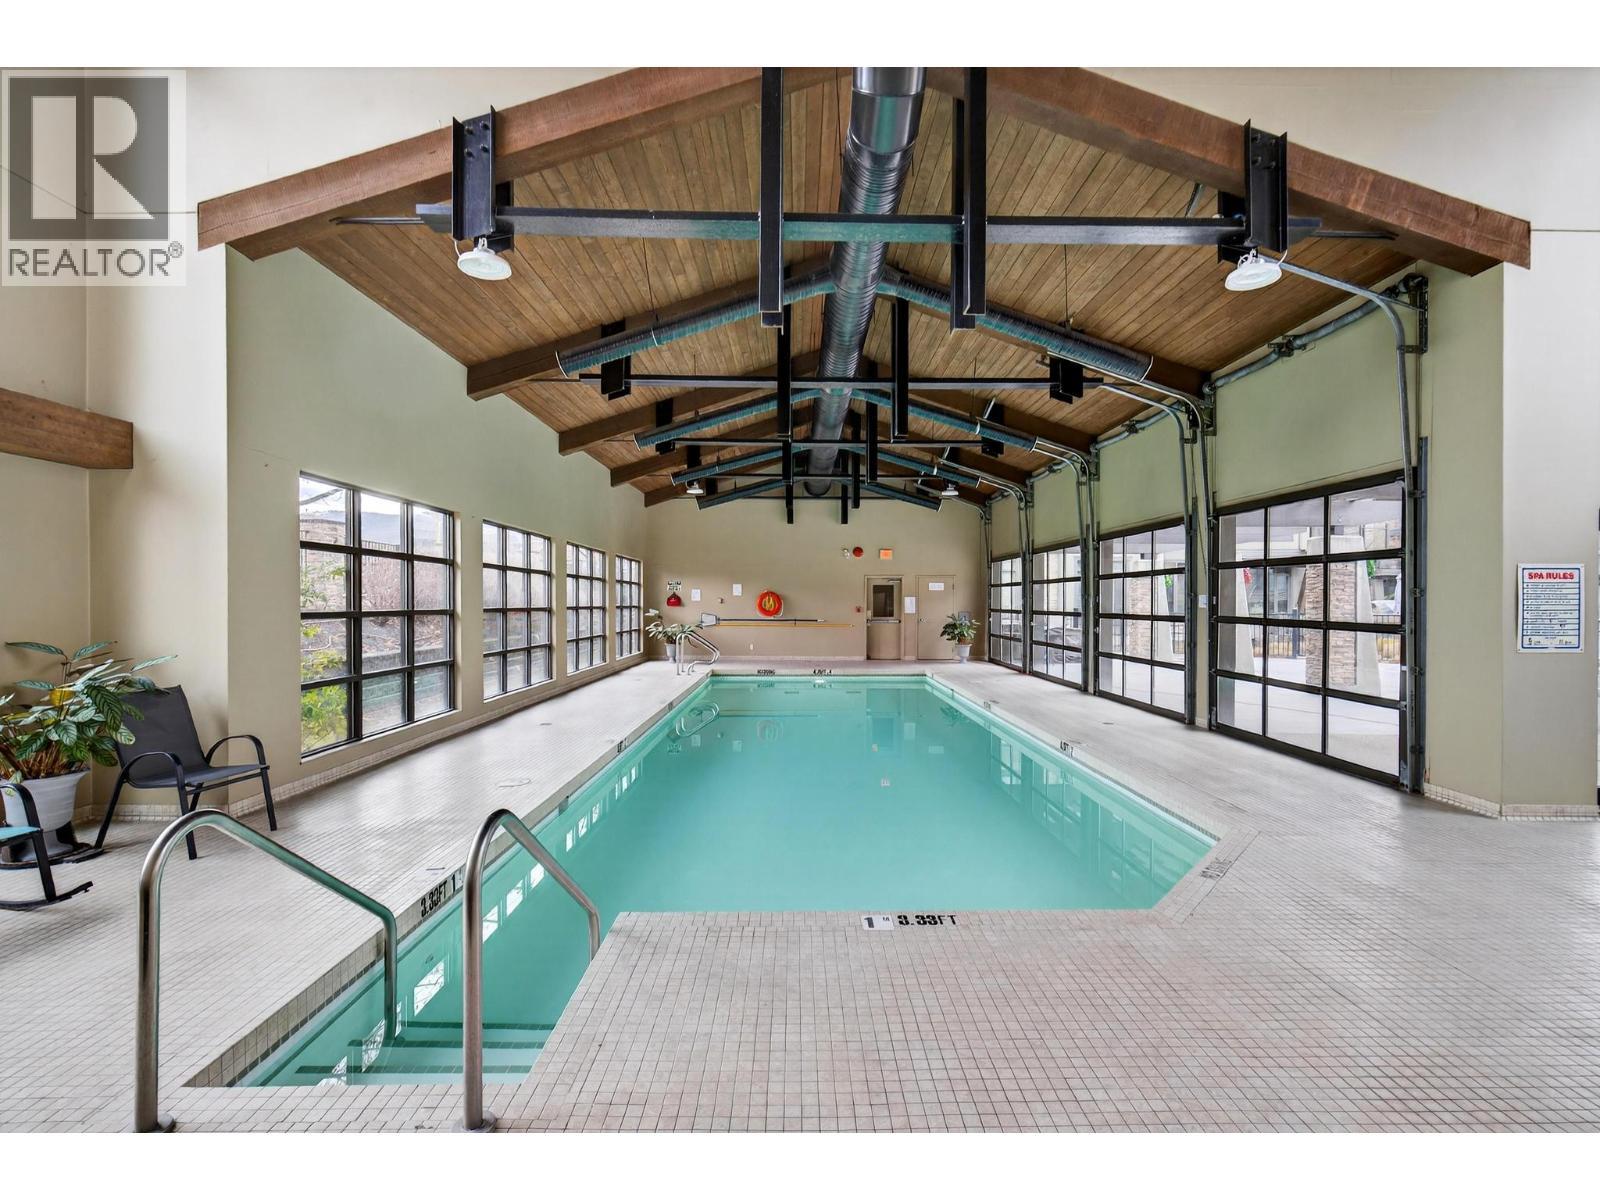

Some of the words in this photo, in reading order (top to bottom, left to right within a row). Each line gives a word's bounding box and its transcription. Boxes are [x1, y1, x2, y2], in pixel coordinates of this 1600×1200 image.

[1528, 572, 1544, 580] SPA
[1546, 572, 1574, 580] RULES
[864, 917, 875, 929] 1
[897, 915, 957, 926] 3.33FT
